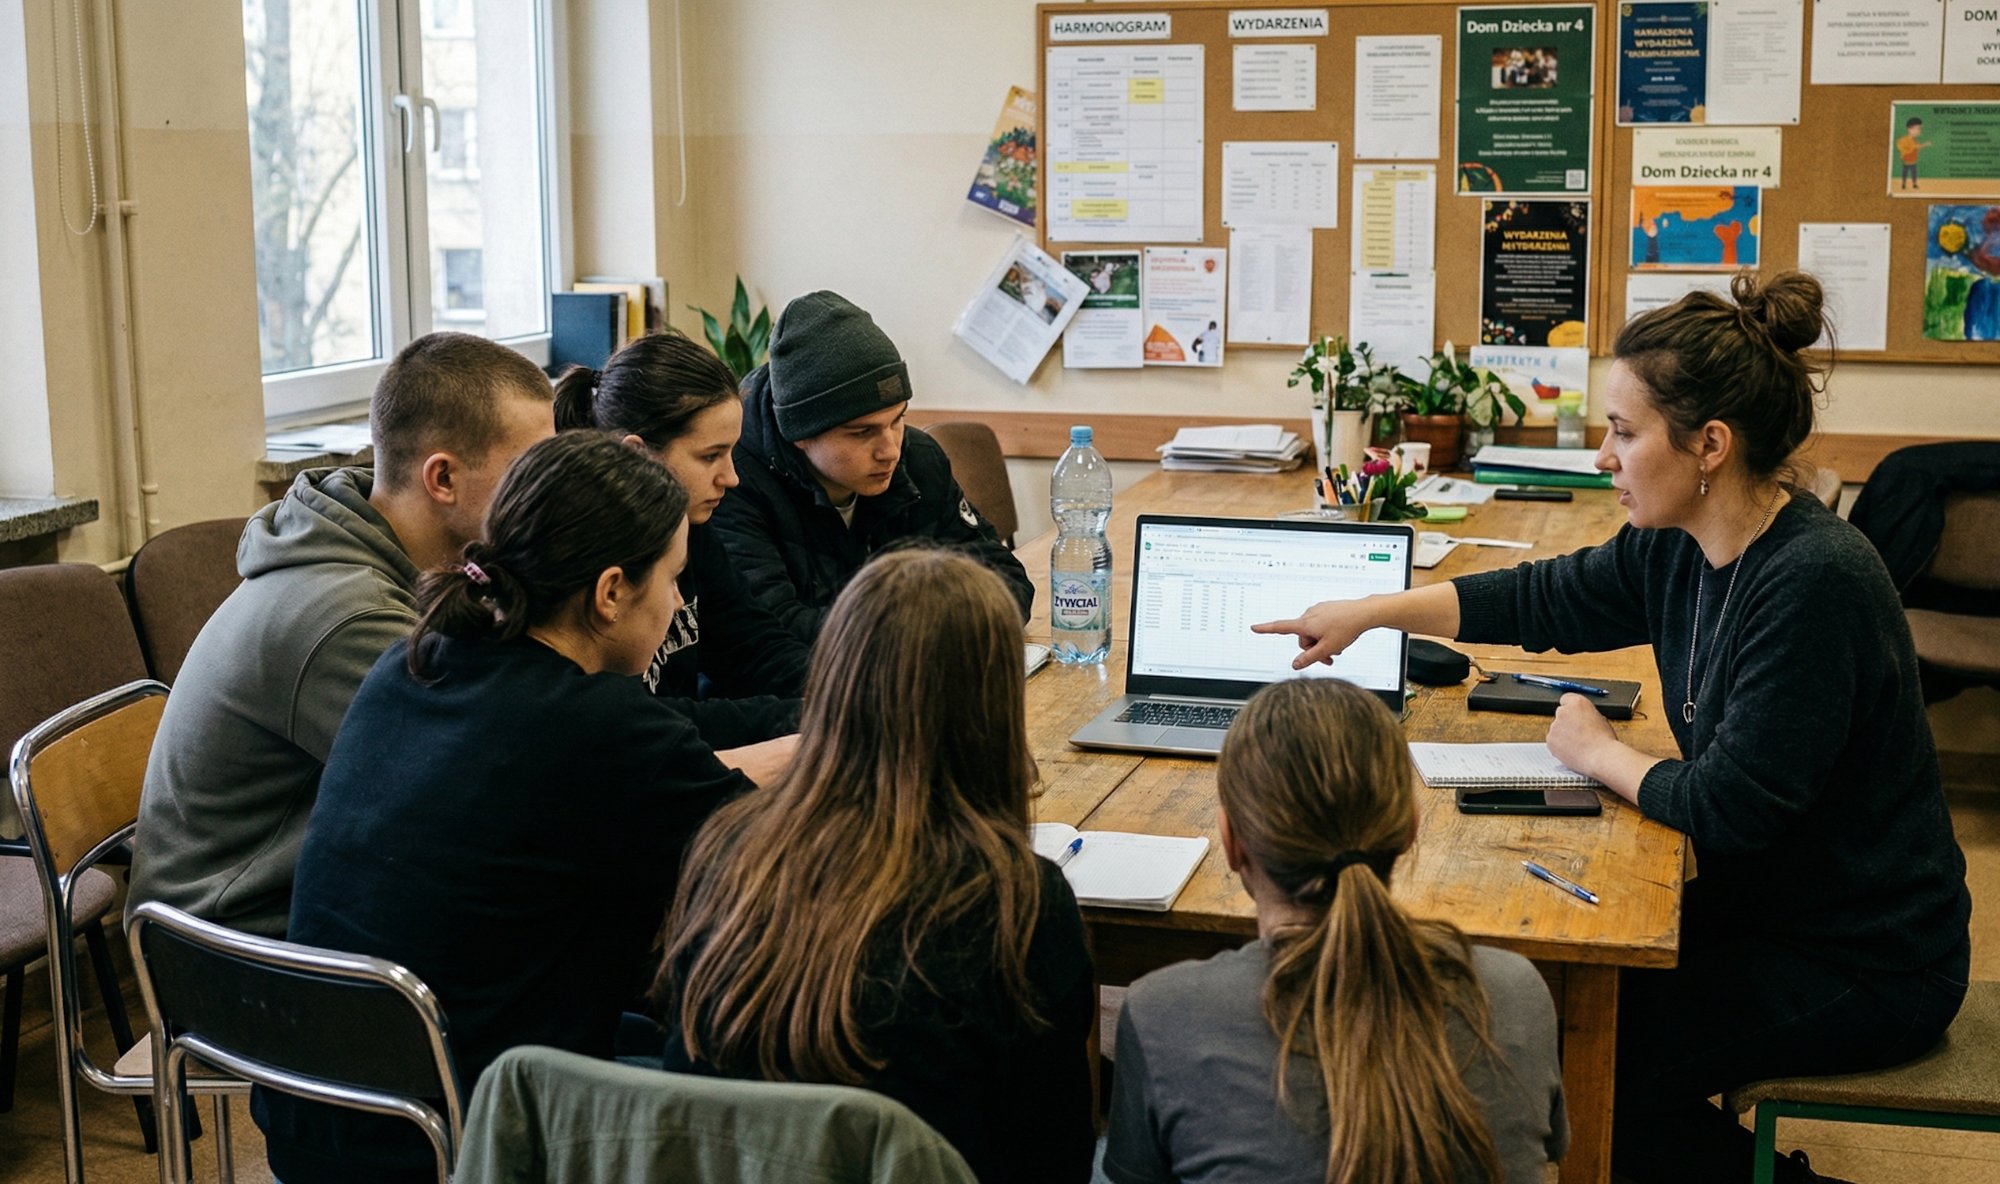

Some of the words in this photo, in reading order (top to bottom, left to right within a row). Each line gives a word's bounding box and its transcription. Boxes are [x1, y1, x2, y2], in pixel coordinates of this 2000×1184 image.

[1964, 9, 1998, 22] DOM
[1054, 20, 1167, 35] HARMONOGRAM
[1232, 17, 1324, 31] WYDARZENIA
[1467, 19, 1499, 34] Dom
[1502, 18, 1553, 34] Dziecka
[1556, 20, 1572, 32] nr
[1574, 18, 1584, 32] 4
[1641, 165, 1676, 178] Dom
[1680, 164, 1738, 178] Dziecka
[1742, 167, 1758, 178] nr
[1762, 165, 1772, 178] 4
[1503, 230, 1568, 240] WYDARZENIA
